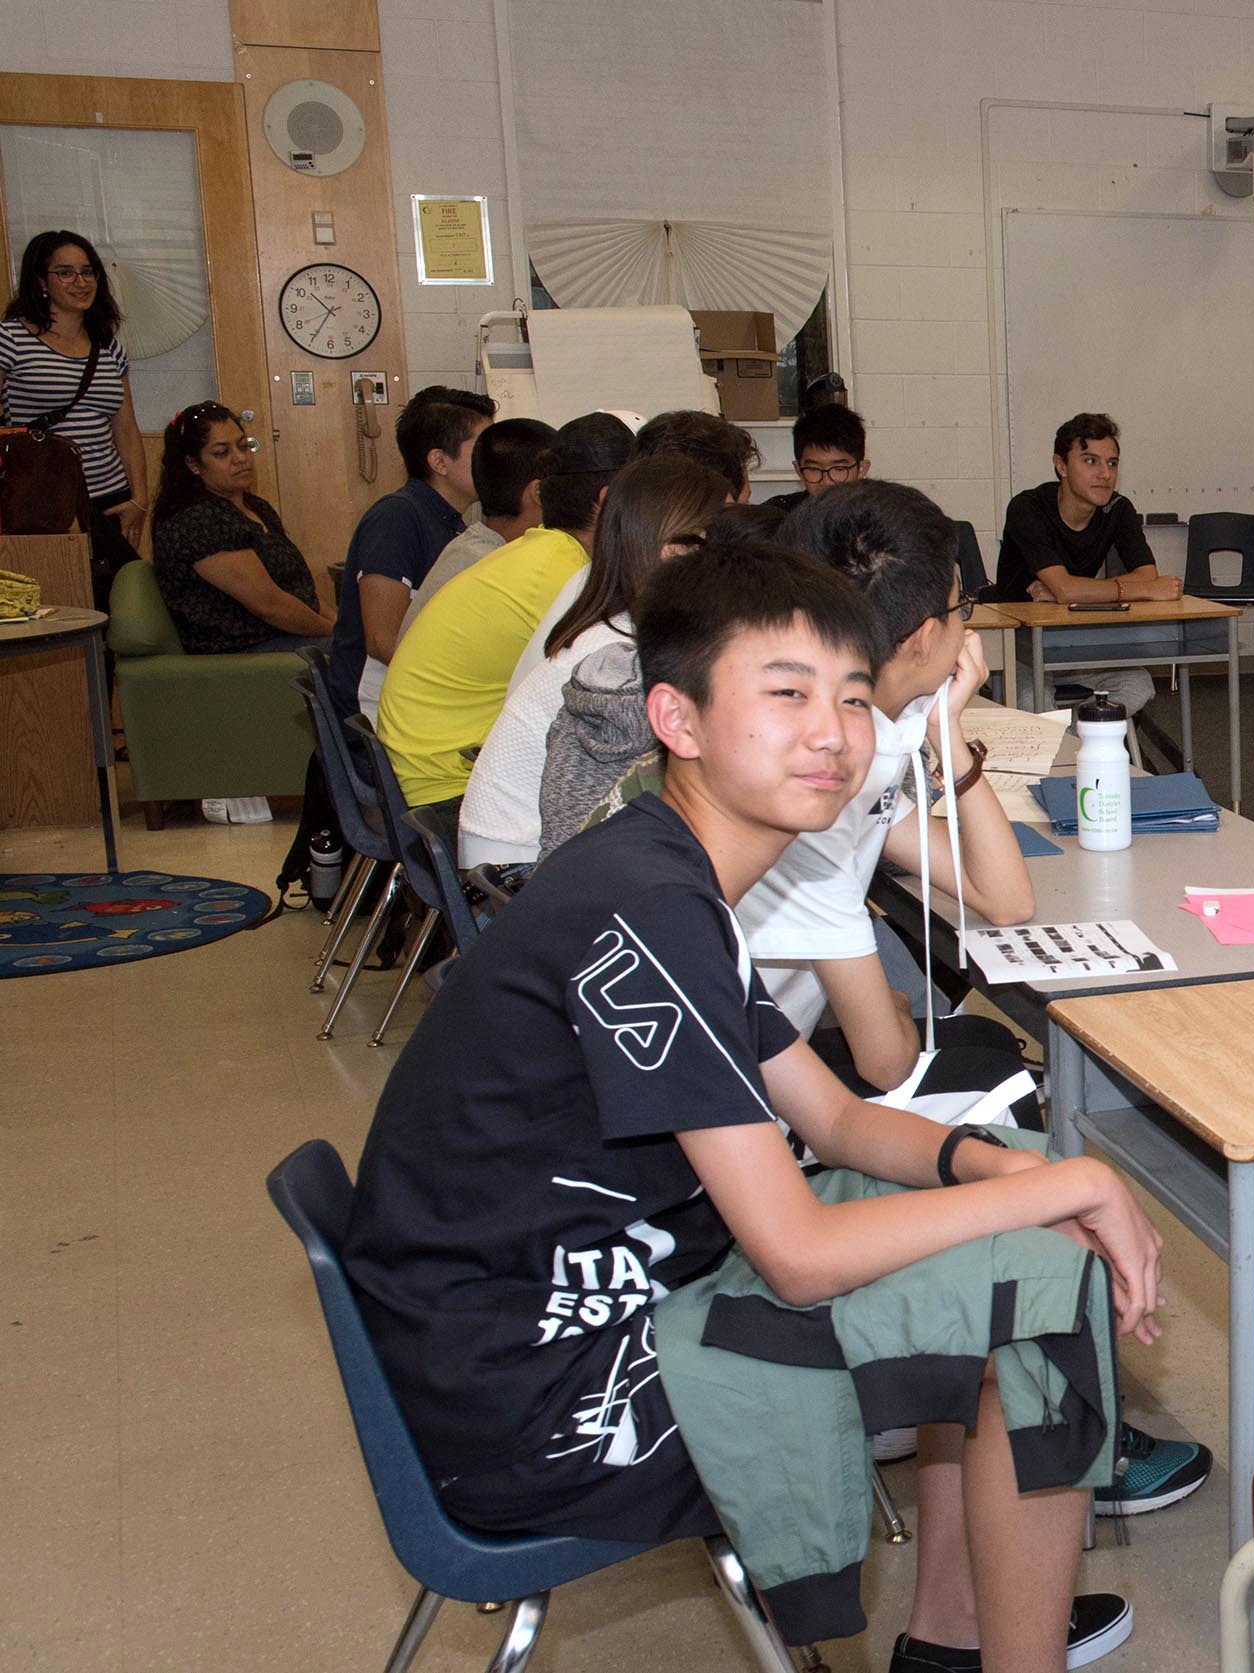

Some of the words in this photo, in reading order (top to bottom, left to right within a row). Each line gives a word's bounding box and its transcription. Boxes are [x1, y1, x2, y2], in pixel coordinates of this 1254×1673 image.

[308, 276, 318, 287] 11
[323, 273, 336, 284] 12
[345, 281, 350, 289] 1
[295, 287, 306, 298] 10
[357, 293, 365, 302] 2
[290, 304, 298, 313] 9
[363, 309, 370, 319] 3
[296, 320, 303, 330] 8
[358, 325, 365, 334] 4
[327, 340, 335, 349] 6
[344, 337, 352, 347] 5
